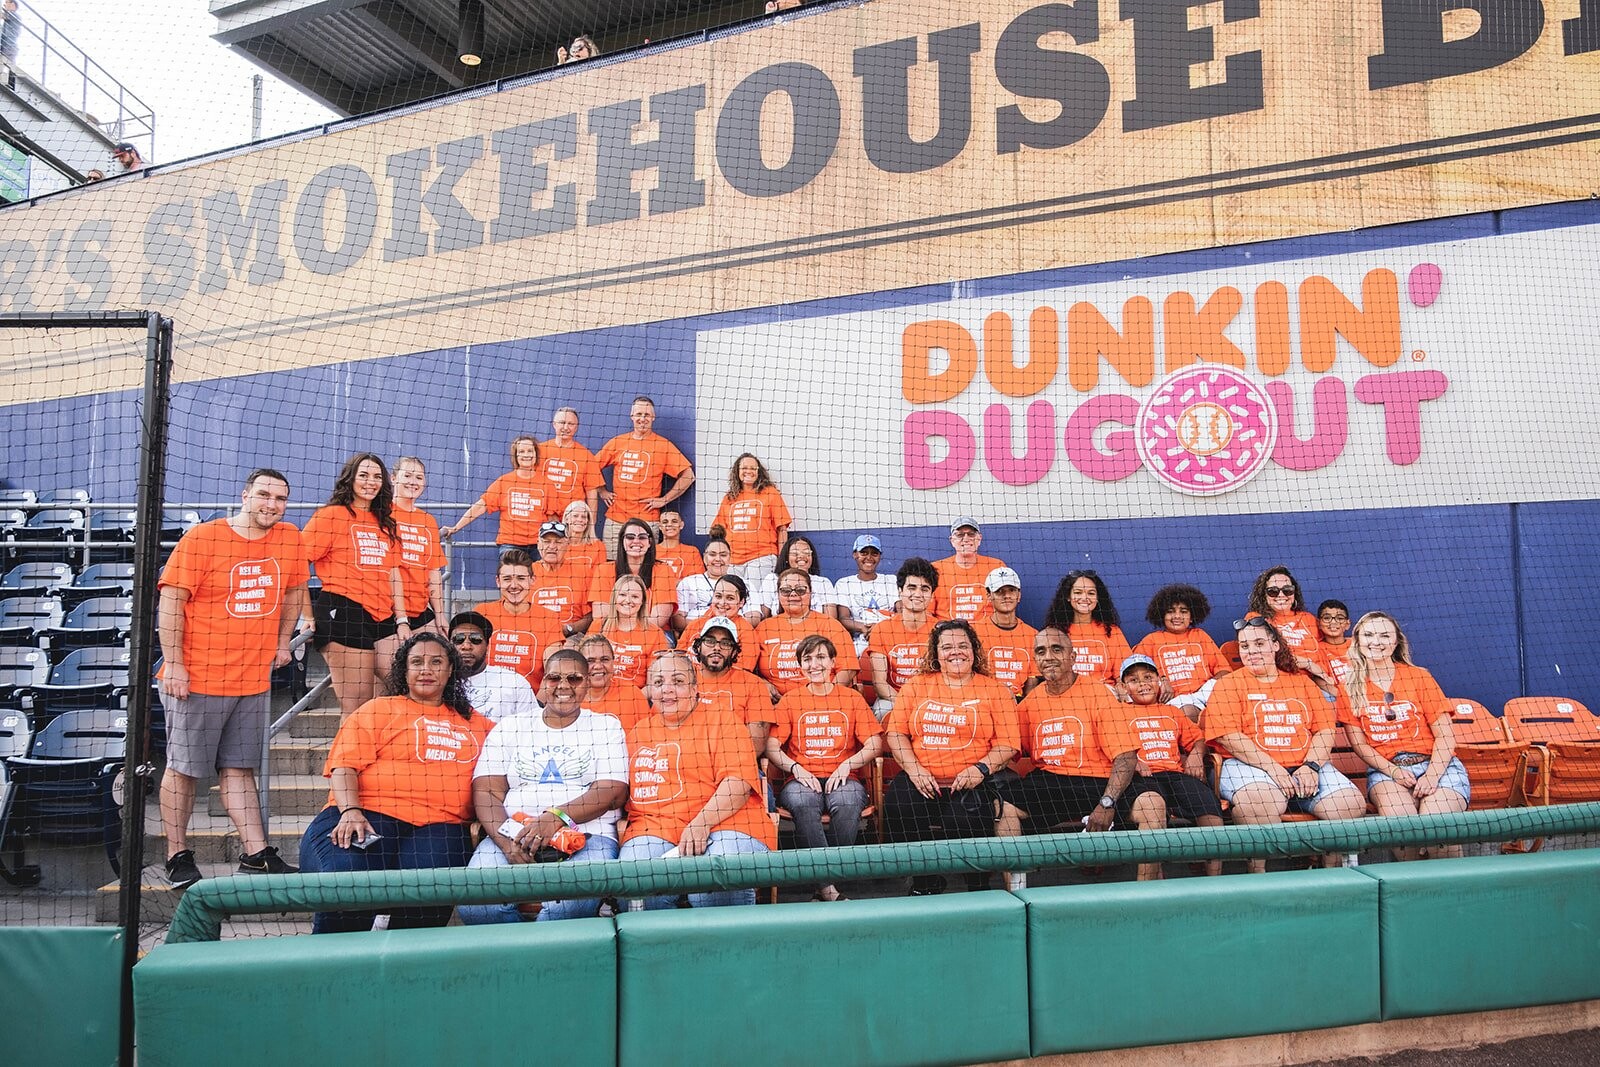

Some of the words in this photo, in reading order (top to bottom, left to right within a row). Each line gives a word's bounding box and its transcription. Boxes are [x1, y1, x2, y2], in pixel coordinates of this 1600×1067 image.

[141, 0, 1264, 306] SMOKEHOUSE
[902, 262, 1442, 404] DUNKIN'
[235, 589, 266, 600] SUMMER
[495, 643, 514, 652] ABOUT
[514, 645, 529, 655] FREE
[806, 715, 818, 724] ASK
[819, 715, 831, 724] ME
[923, 711, 948, 722] ABOUT
[949, 714, 967, 726] FREE
[1264, 714, 1285, 724] ABOUT
[1286, 713, 1302, 725] FREE
[805, 727, 826, 736] ABOUT
[827, 726, 842, 737] FREE
[922, 723, 956, 735] SUMMER
[805, 738, 835, 747] SUMMER
[923, 735, 949, 746] MEALS!
[1041, 735, 1061, 747] ABOUT
[1061, 733, 1075, 746] FREE
[532, 745, 576, 759] ANGEL
[633, 785, 659, 799] MEALS!
